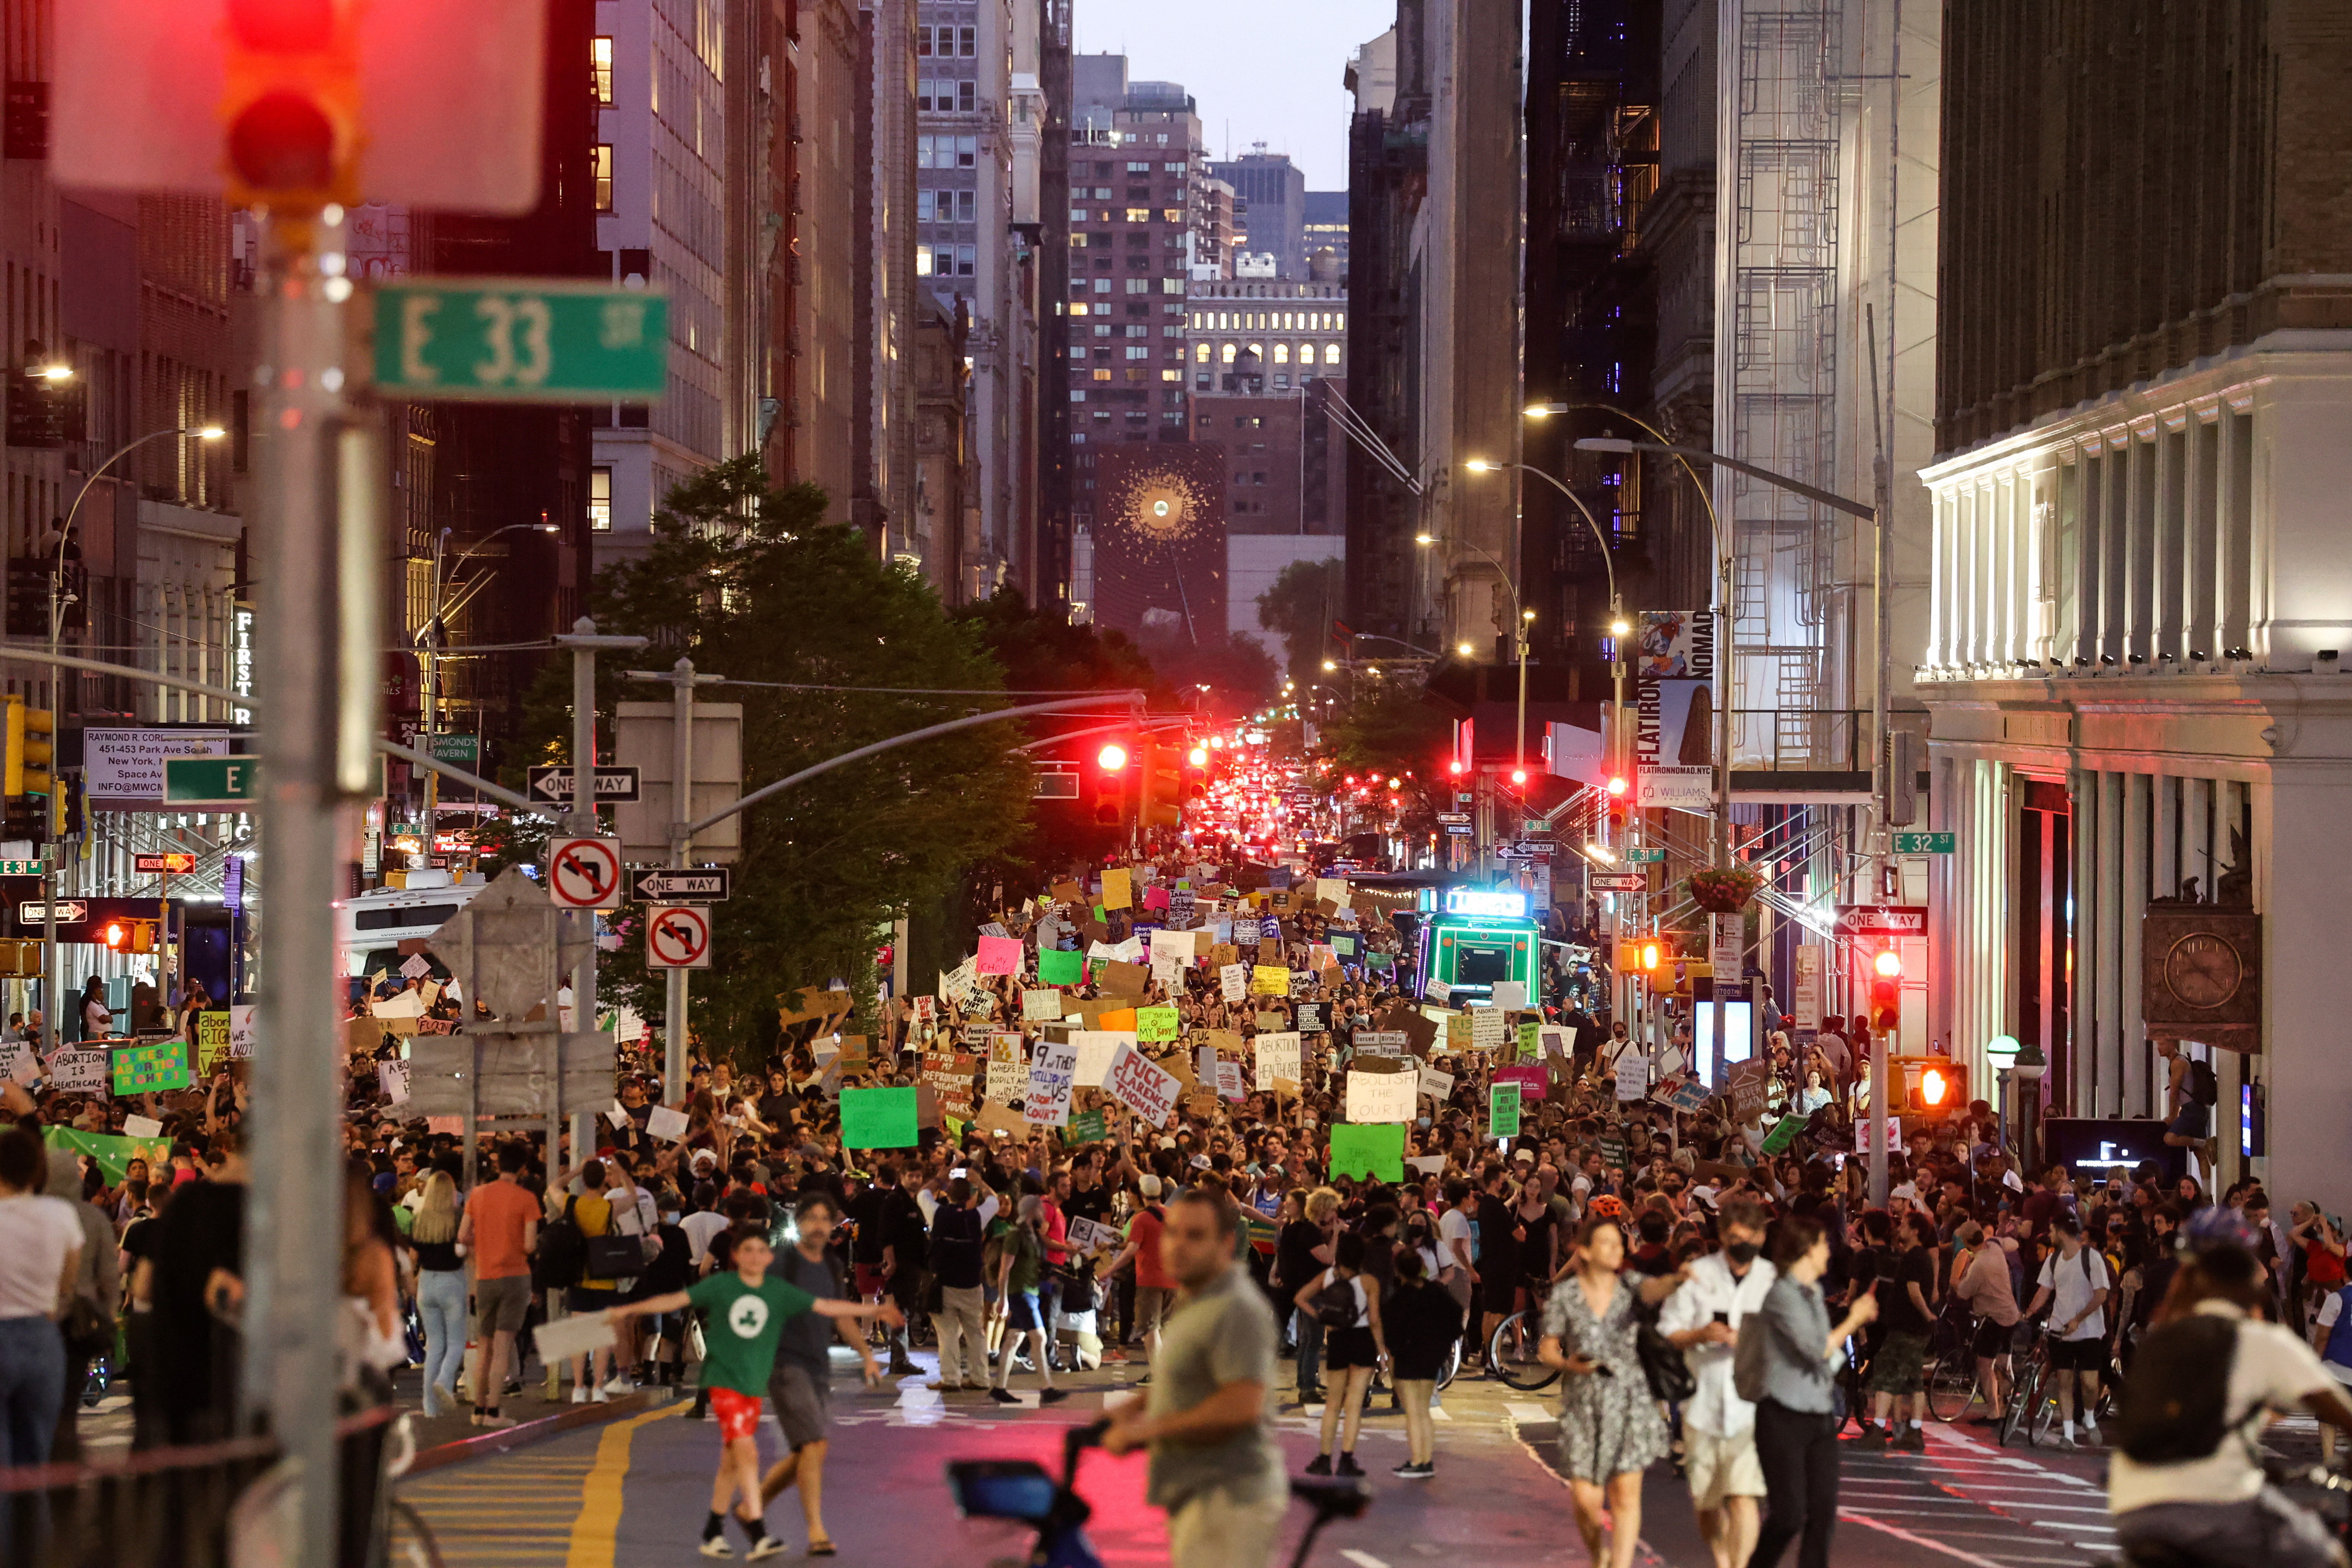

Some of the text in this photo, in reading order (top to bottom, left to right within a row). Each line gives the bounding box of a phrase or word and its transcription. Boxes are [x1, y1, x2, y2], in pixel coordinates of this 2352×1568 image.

[403, 296, 552, 381] E 33
[1692, 612, 1713, 680] NOMAD
[238, 612, 251, 696] FIRST
[1638, 676, 1660, 765] FLATIRON
[132, 757, 156, 766] York,
[118, 770, 147, 778] Space
[227, 767, 241, 792] E
[546, 778, 624, 791] ONE WAY
[1661, 788, 1706, 797] WILLIAMS
[394, 824, 398, 833] E
[402, 825, 412, 833] 30
[1895, 835, 1950, 852] E 32 ST
[1629, 850, 1635, 860] E
[1639, 849, 1649, 861] 31
[3, 861, 11, 873] E
[15, 861, 27, 873] 31
[647, 879, 715, 891] ONE WAY
[1170, 898, 1181, 906] Life
[1848, 915, 1874, 926] ONE
[1219, 946, 1229, 954] WE
[996, 956, 1008, 965] MY
[1217, 954, 1231, 962] OUT
[981, 963, 1014, 973] CHOICE
[970, 986, 984, 995] NOT
[918, 996, 931, 1005] BANS
[974, 996, 988, 1005] BODY
[1023, 991, 1060, 1004] ABORTION
[965, 999, 980, 1009] NOT
[201, 1014, 231, 1027] abort
[420, 1020, 452, 1032] FUCKING
[232, 1030, 245, 1042] WE
[1139, 1028, 1153, 1038] MY
[233, 1044, 255, 1057] NOT
[1260, 1038, 1298, 1053] ABORTION
[55, 1053, 105, 1068] ABORTION
[120, 1049, 164, 1064] DYKES
[939, 1053, 955, 1063] YOU
[1037, 1045, 1049, 1067] 9
[71, 1066, 85, 1075] IS
[116, 1058, 184, 1075] ABORTION
[991, 1064, 1016, 1073] WHERE
[1123, 1051, 1168, 1093] FUCK
[1259, 1061, 1300, 1079] HEALTHCARE
[989, 1076, 1015, 1084] BODILY
[1349, 1072, 1415, 1086] ABOLISH
[1004, 1087, 1011, 1095] IN
[1051, 1084, 1069, 1102] US
[1114, 1066, 1171, 1112] CLARENCE
[1369, 1088, 1394, 1098] THE
[1656, 1078, 1684, 1098] MY
[1735, 1084, 1762, 1099] NEVER
[1115, 1081, 1160, 1121] THOMAS
[1738, 1096, 1764, 1111] AGAIN
[1026, 1106, 1059, 1121] COURT
